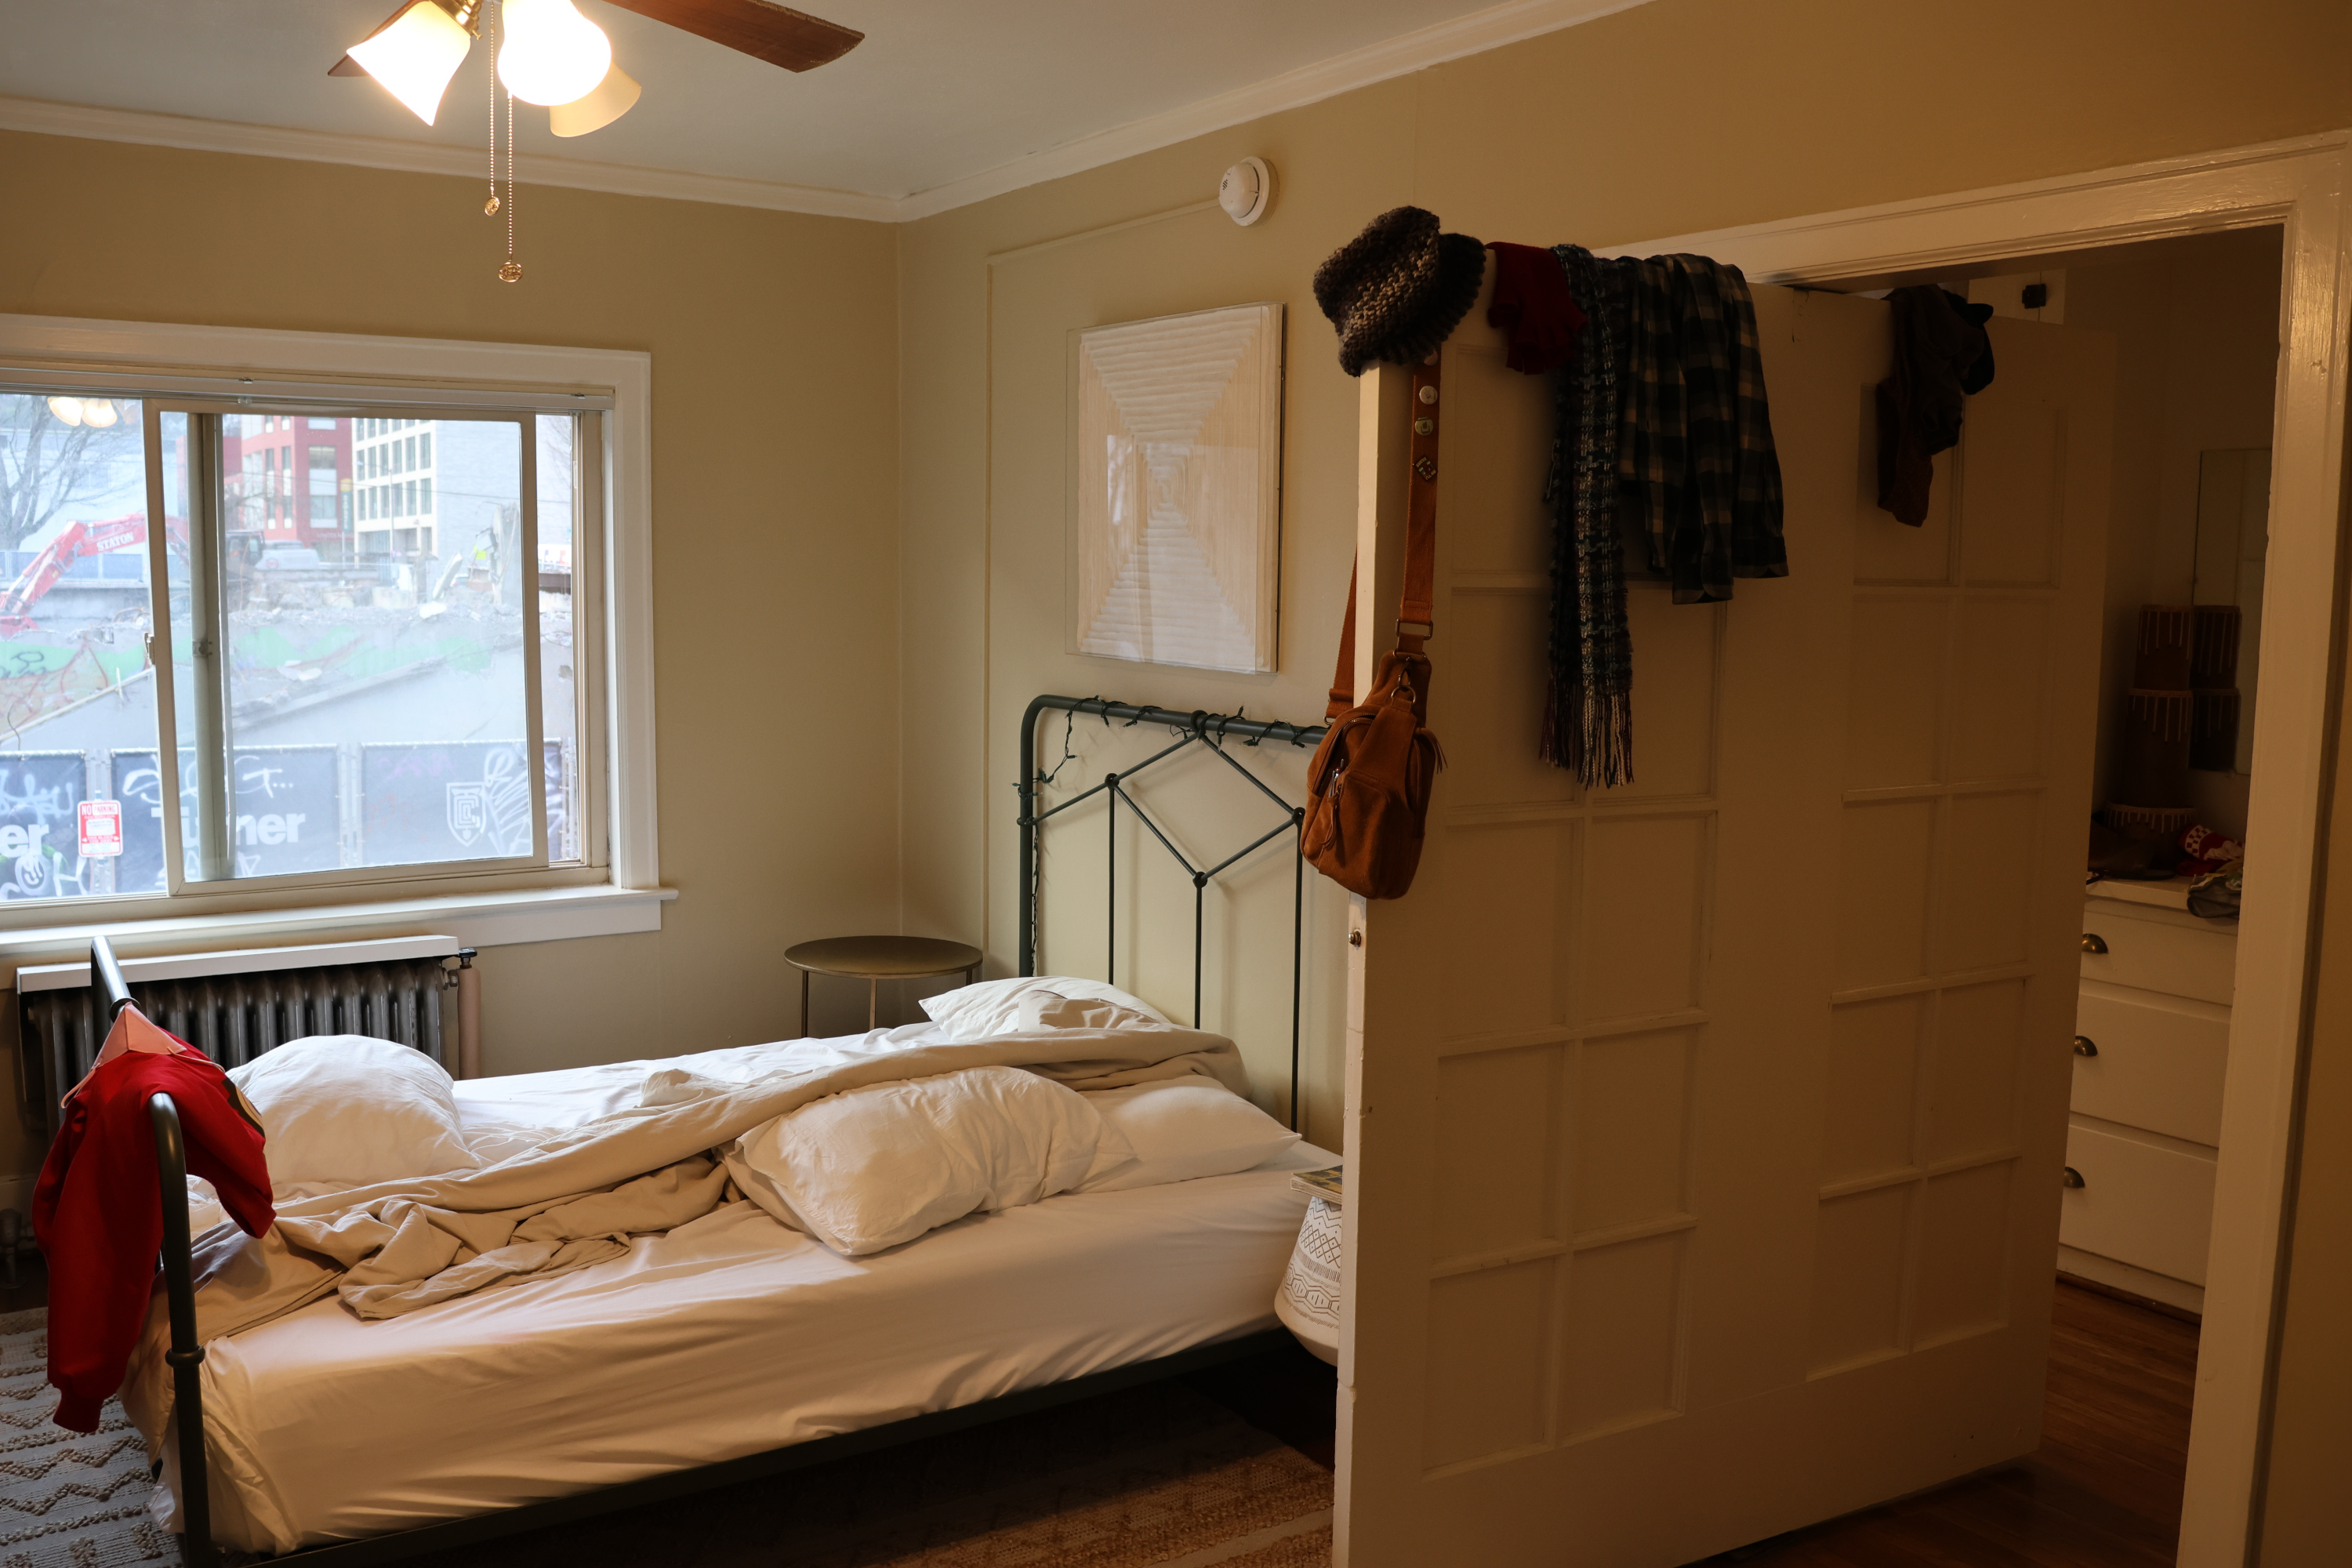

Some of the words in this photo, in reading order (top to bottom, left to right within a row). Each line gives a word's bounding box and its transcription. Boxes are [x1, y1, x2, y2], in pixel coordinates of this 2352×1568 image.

[96, 531, 134, 551] STATON
[82, 804, 92, 815] NO
[94, 804, 115, 813] PARKING
